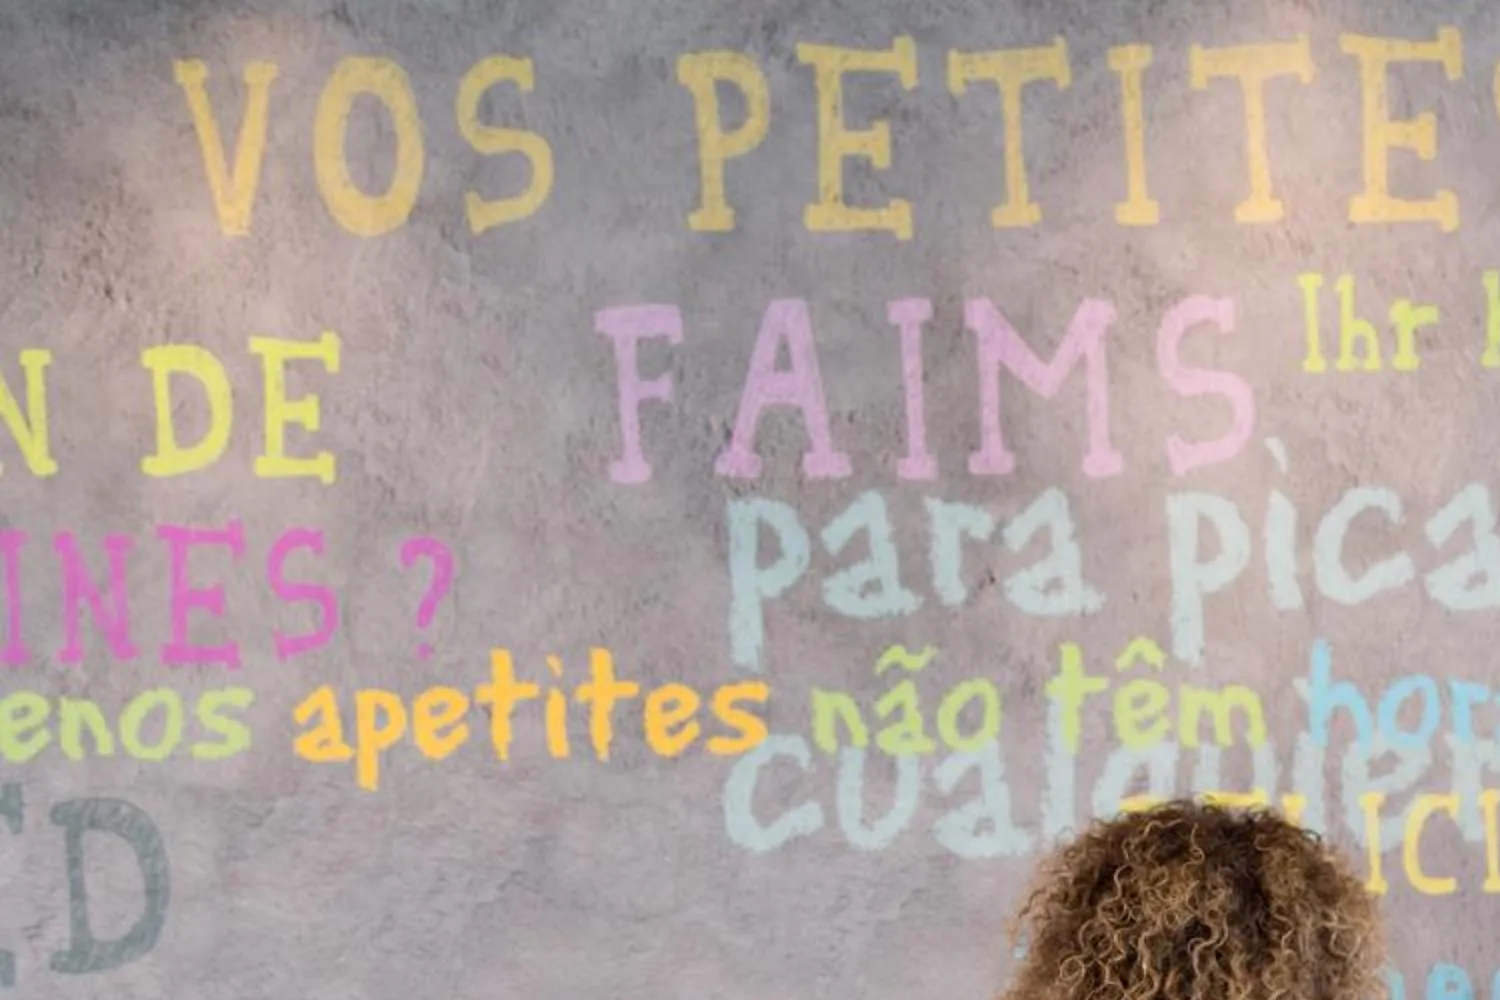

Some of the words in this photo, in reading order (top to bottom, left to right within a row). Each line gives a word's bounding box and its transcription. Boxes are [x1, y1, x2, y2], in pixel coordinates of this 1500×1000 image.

[174, 55, 554, 236] VOS
[594, 295, 1257, 485] FAIMS
[1298, 273, 1439, 371] Ihr
[141, 332, 341, 485] DE
[401, 536, 456, 660] ?
[726, 487, 1106, 672] para
[0, 686, 255, 762] enos
[292, 647, 770, 791] apetites
[811, 645, 1002, 756] não
[1045, 637, 1267, 753] têm
